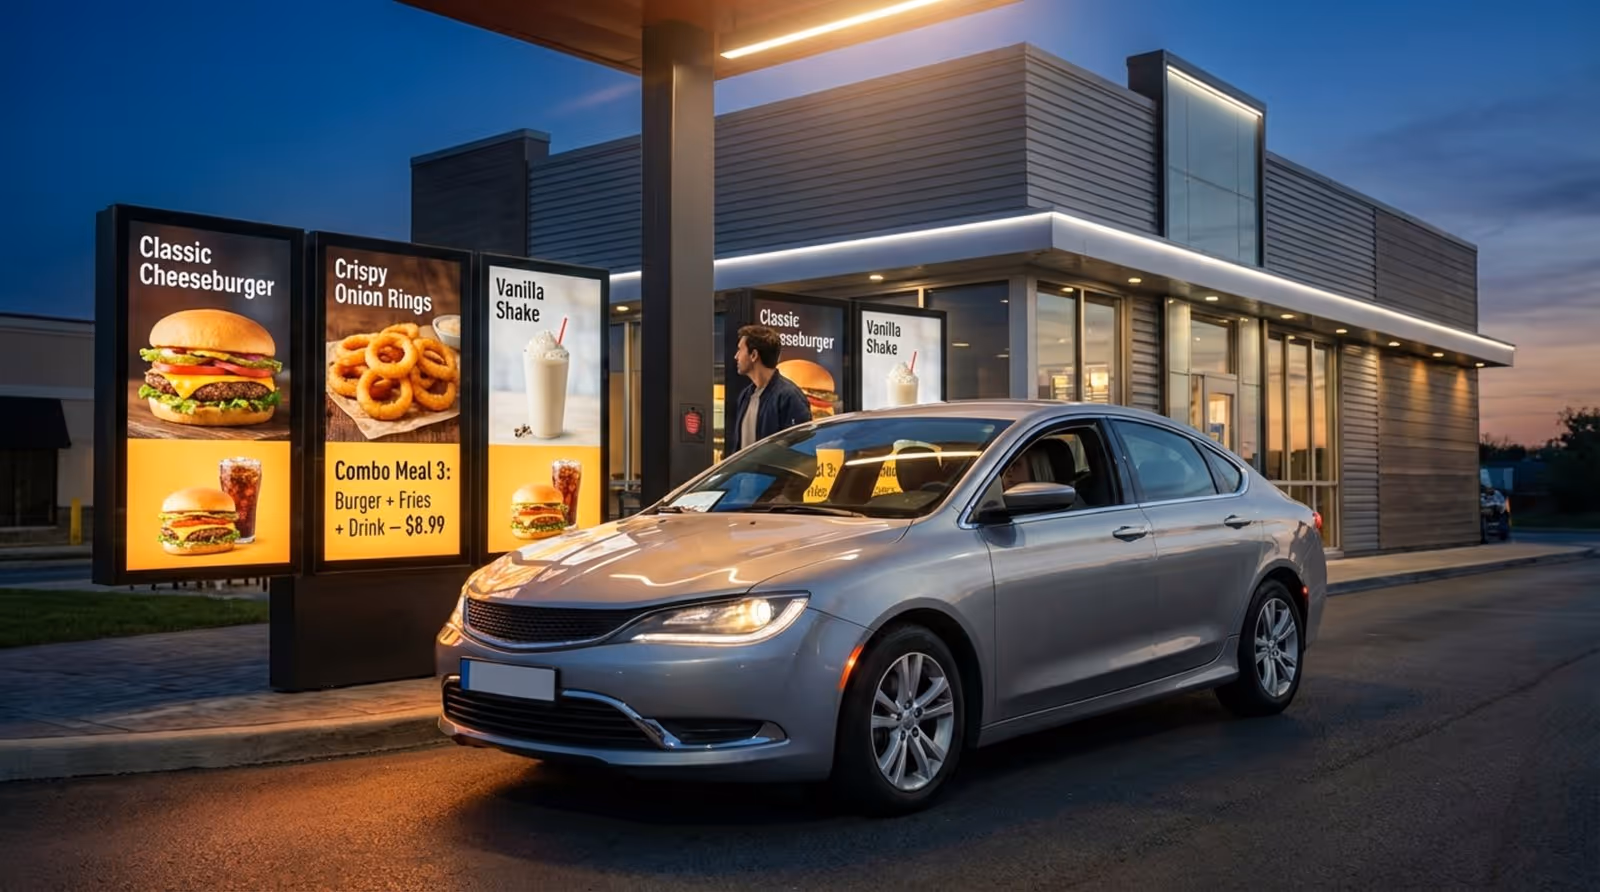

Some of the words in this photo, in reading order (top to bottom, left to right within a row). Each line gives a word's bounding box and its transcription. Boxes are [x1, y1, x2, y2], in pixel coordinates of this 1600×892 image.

[139, 235, 212, 265] Classic
[139, 261, 275, 300] Cheeseburger
[335, 257, 388, 287] Crispy
[335, 283, 384, 307] Onion
[389, 288, 432, 315] Rings
[495, 277, 544, 301] Vanilla
[495, 300, 540, 323] Shake
[759, 308, 800, 328] Classic
[866, 319, 901, 338] Vanilla
[780, 331, 835, 353] eseburger
[866, 337, 898, 356] Shake
[335, 460, 390, 481] Combo
[395, 460, 432, 481] Meal
[436, 461, 451, 481] 3:
[335, 490, 382, 514] Burger
[386, 496, 395, 506] +
[399, 490, 431, 509] Fries
[335, 524, 344, 535] +
[349, 517, 385, 538] Drink
[405, 514, 445, 537] $8.99
